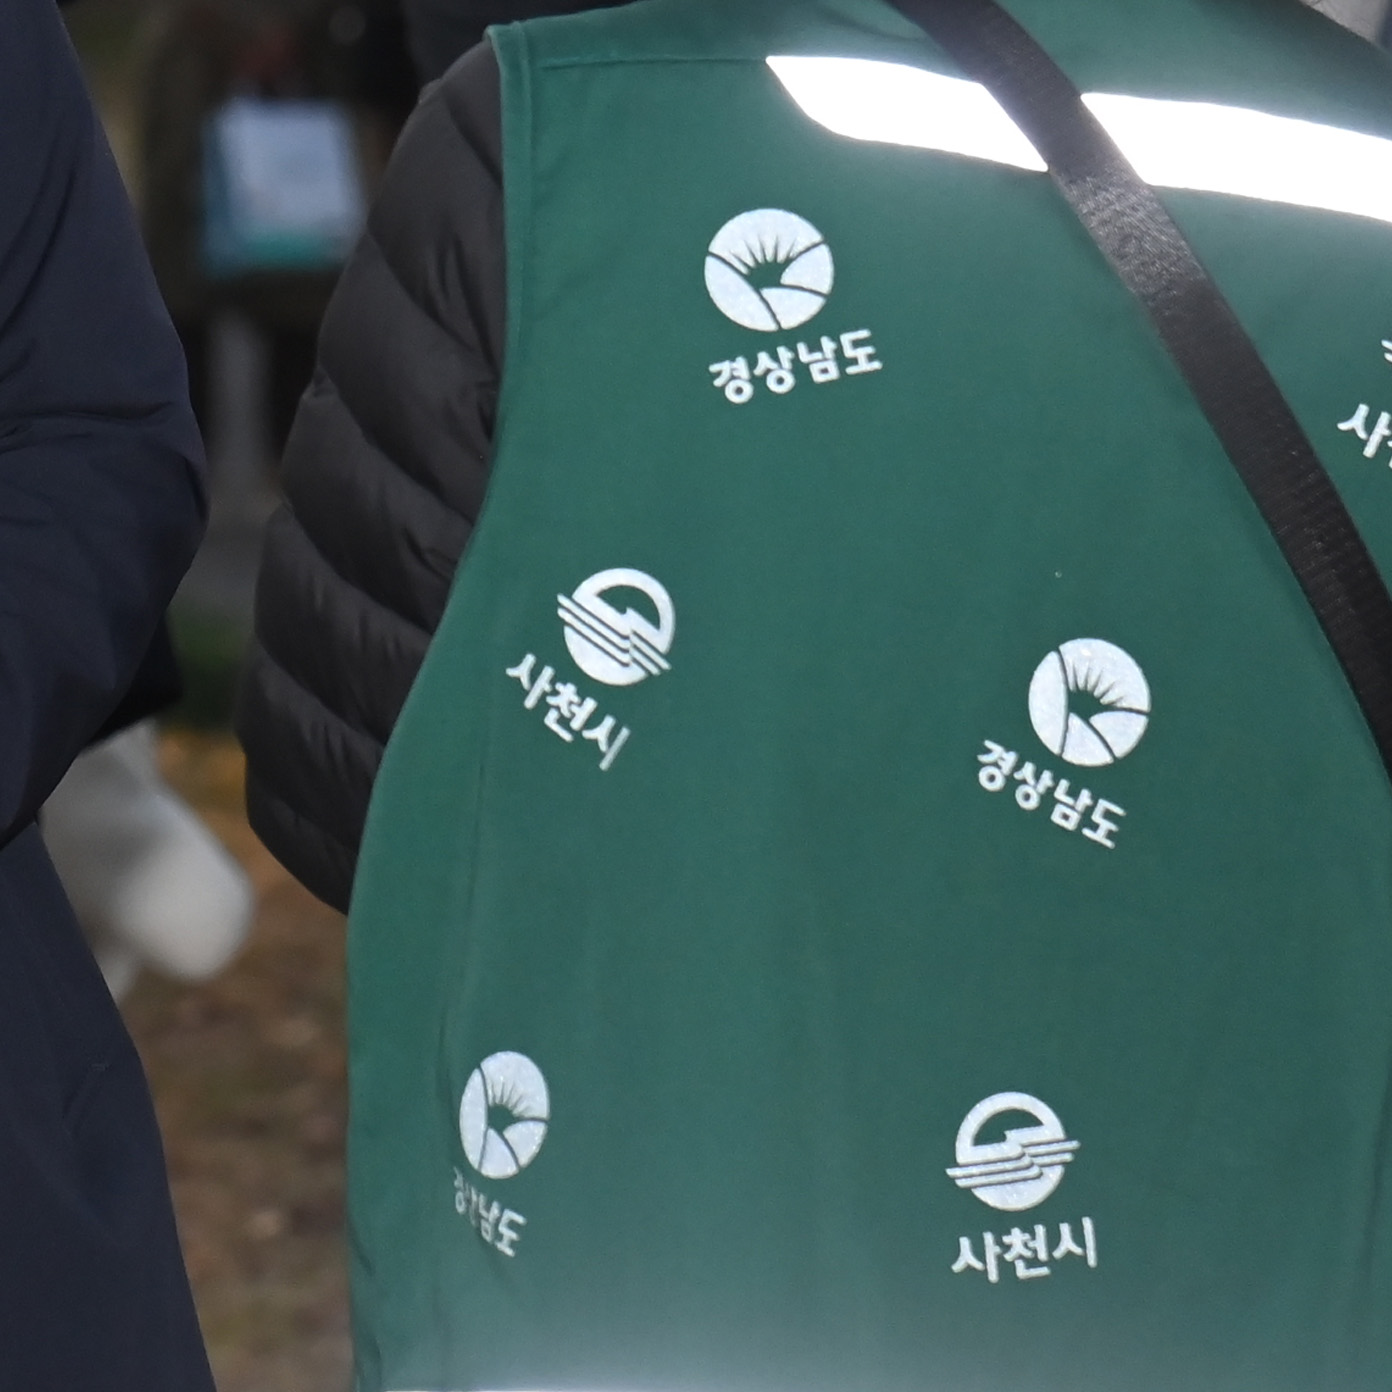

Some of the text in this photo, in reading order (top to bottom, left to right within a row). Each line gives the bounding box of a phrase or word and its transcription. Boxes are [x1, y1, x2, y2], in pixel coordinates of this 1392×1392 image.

[708, 328, 884, 404] 경상남도
[1337, 403, 1392, 469] 사
[506, 653, 631, 772] 사천시
[977, 739, 1127, 850] 경상남도
[951, 1216, 1097, 1284] 사천시
